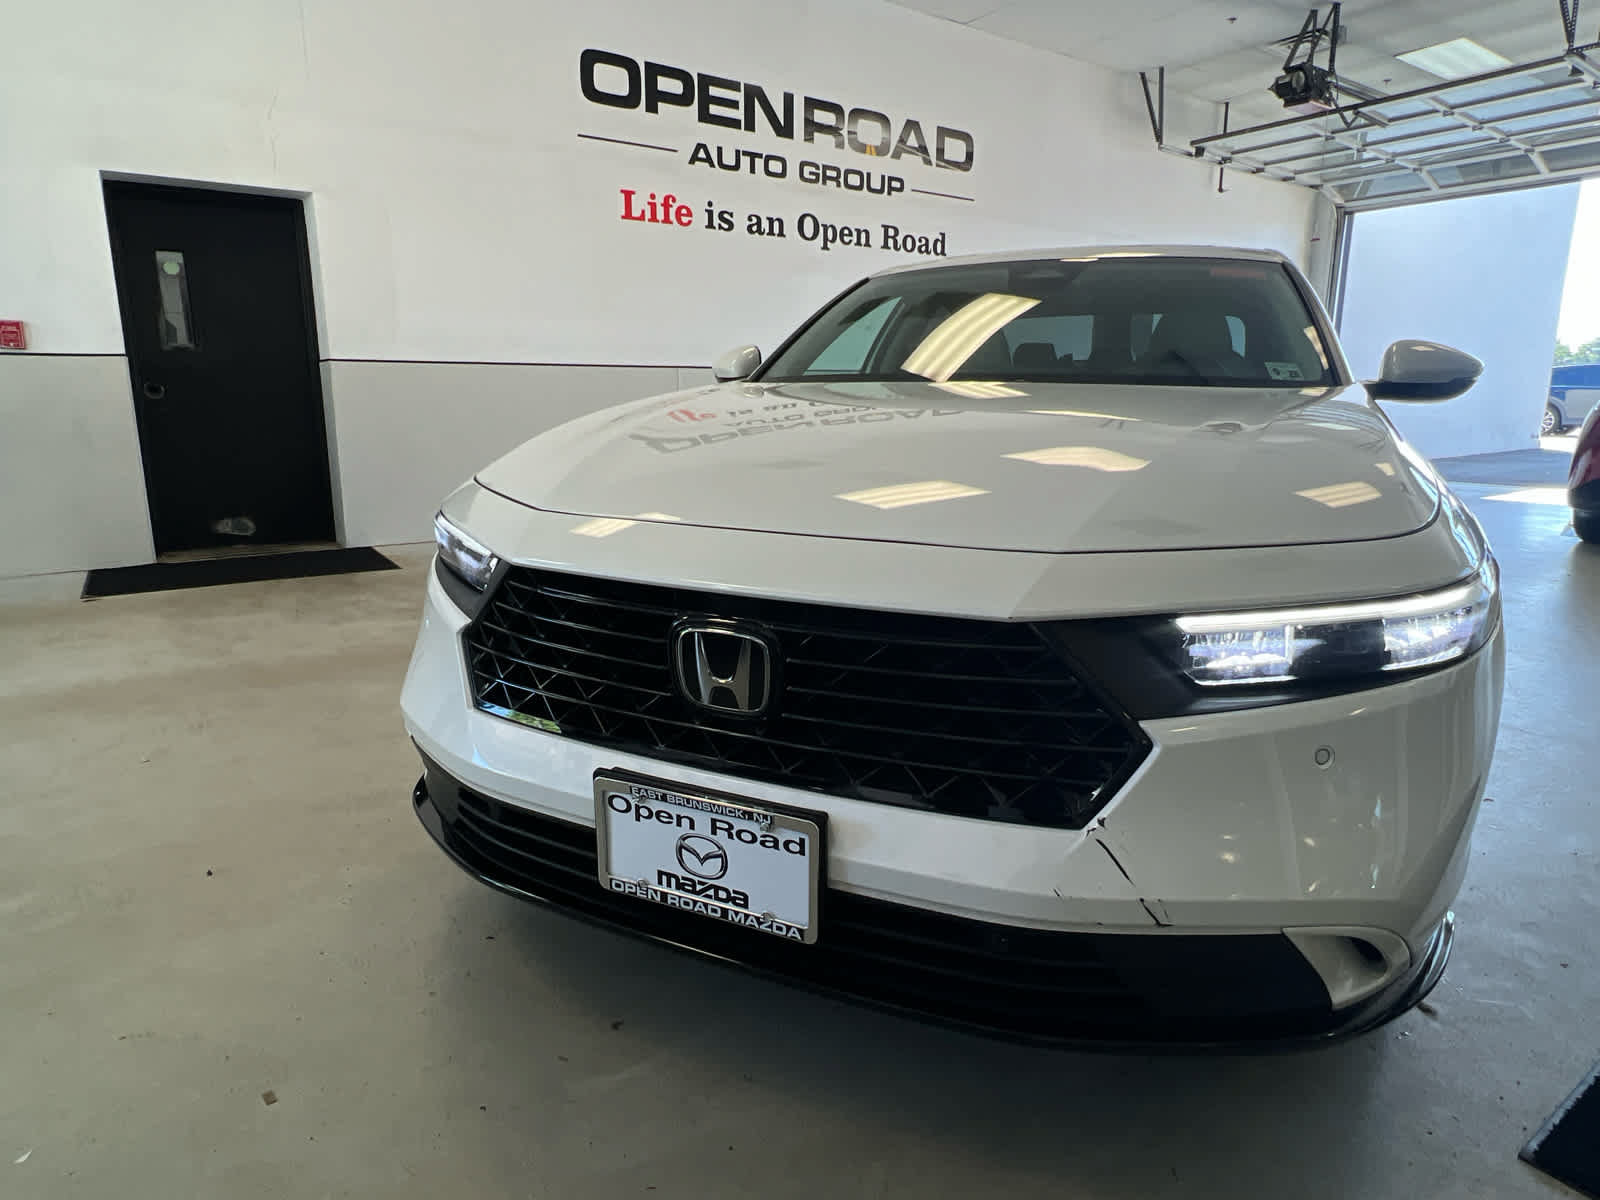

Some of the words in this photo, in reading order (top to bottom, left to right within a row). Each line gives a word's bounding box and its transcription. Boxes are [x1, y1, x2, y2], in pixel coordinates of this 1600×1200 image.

[579, 48, 795, 140] OPEN
[803, 95, 975, 172] ROAD
[688, 142, 788, 179] AUTO
[799, 160, 905, 196] GROUP
[620, 188, 693, 227] Life
[704, 201, 734, 232] is
[746, 212, 786, 238] an
[797, 213, 872, 251] Open
[880, 224, 947, 257] Road
[607, 794, 696, 830] Open
[710, 817, 806, 856] Road
[631, 786, 663, 801] EAST
[753, 811, 772, 825] NJ
[611, 878, 661, 902] OPEN
[667, 893, 721, 917] ROAD
[727, 909, 802, 941] MAZDA
